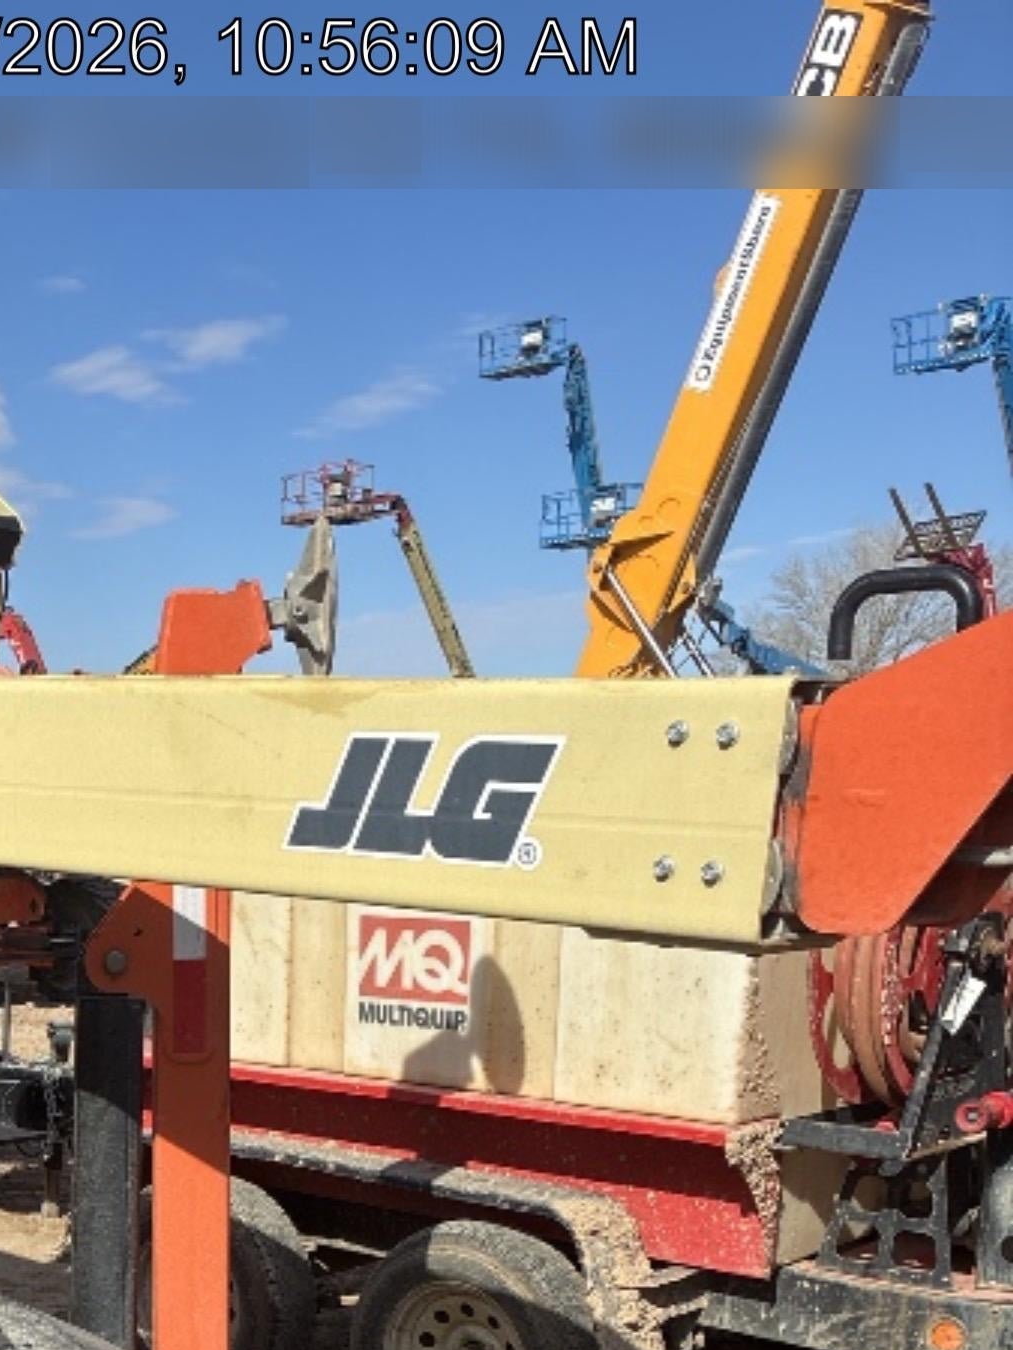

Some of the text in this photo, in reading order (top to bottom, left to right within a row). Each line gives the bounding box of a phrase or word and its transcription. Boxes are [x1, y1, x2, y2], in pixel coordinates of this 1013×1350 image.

[286, 736, 560, 864] JLG
[358, 926, 469, 993] MQ
[358, 1002, 466, 1030] MULTIQUIP
